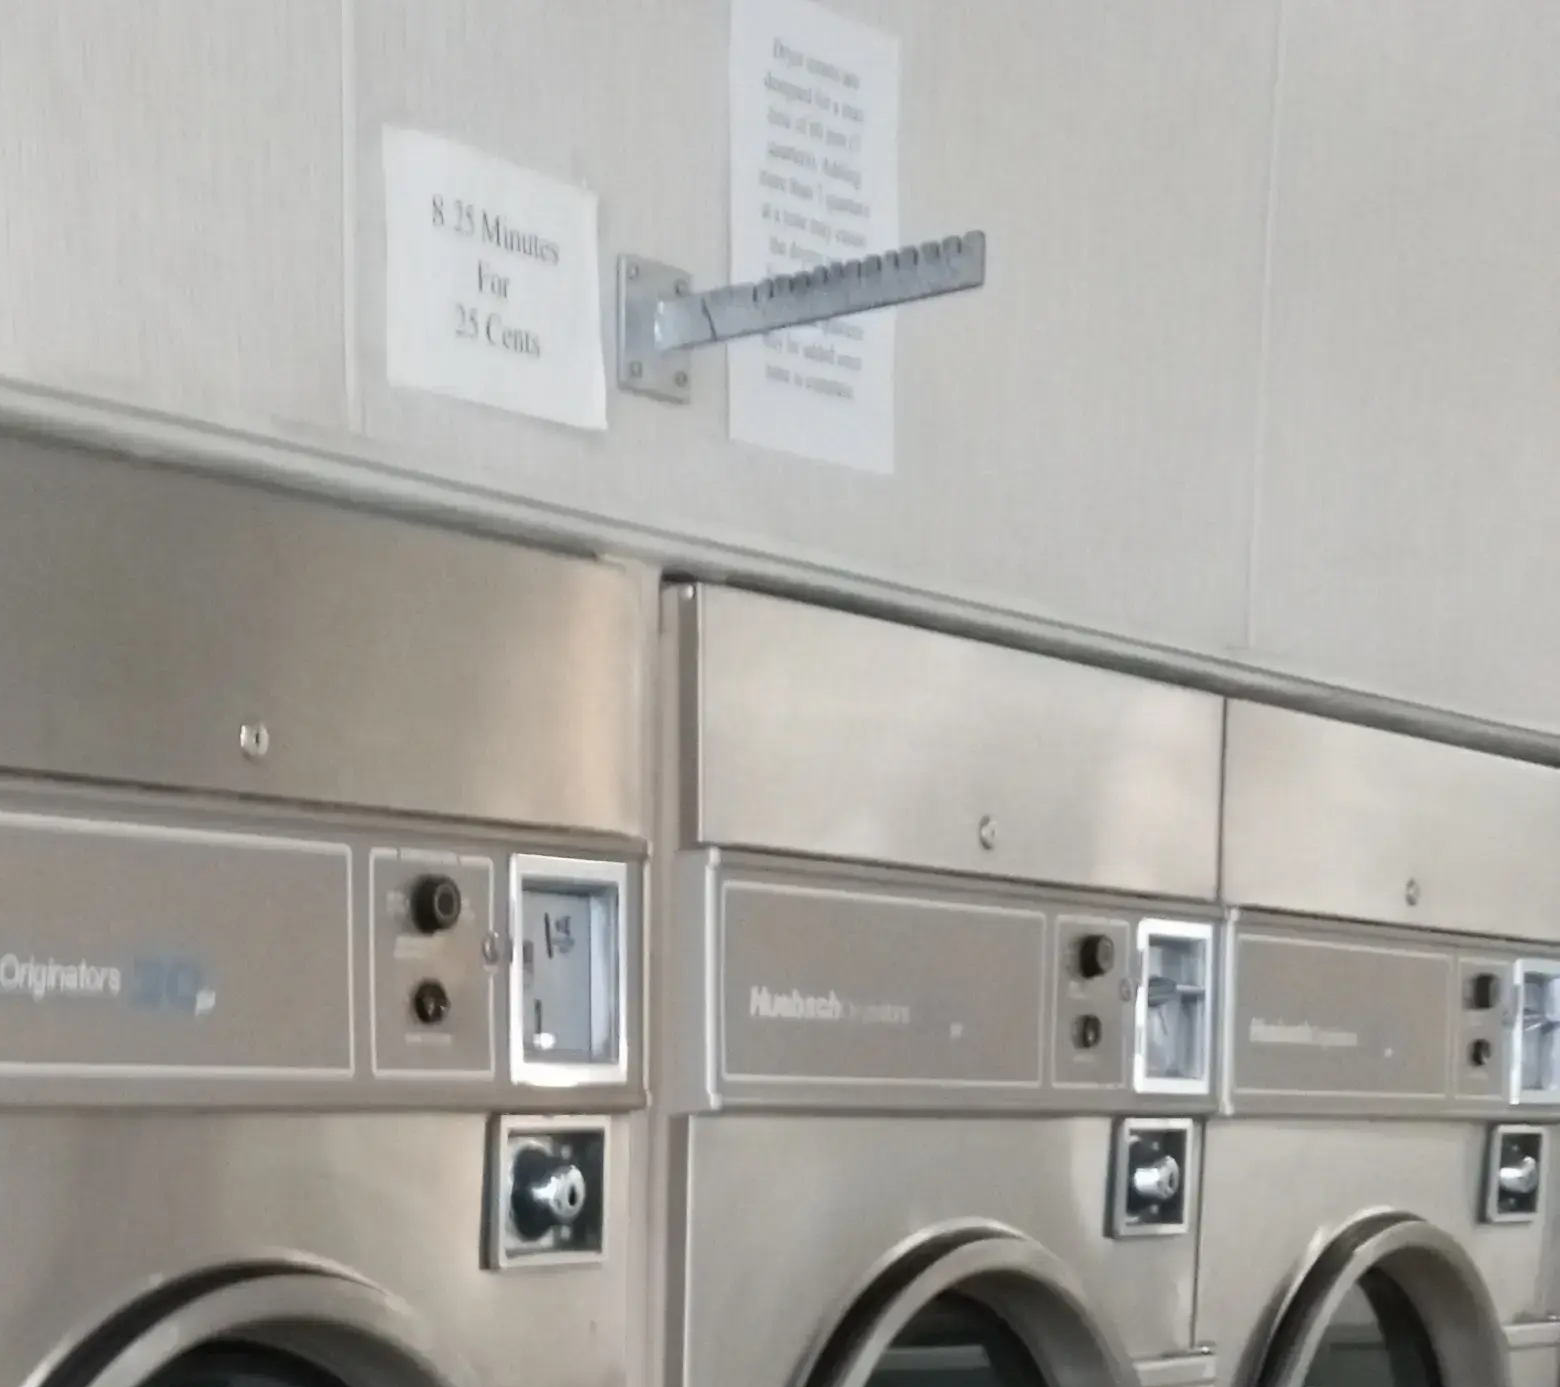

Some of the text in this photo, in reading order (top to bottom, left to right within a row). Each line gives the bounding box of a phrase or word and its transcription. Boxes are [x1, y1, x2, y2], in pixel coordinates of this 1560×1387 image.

[482, 209, 560, 266] Minutes
[477, 258, 510, 298] For
[455, 303, 541, 358] 25 Cents
